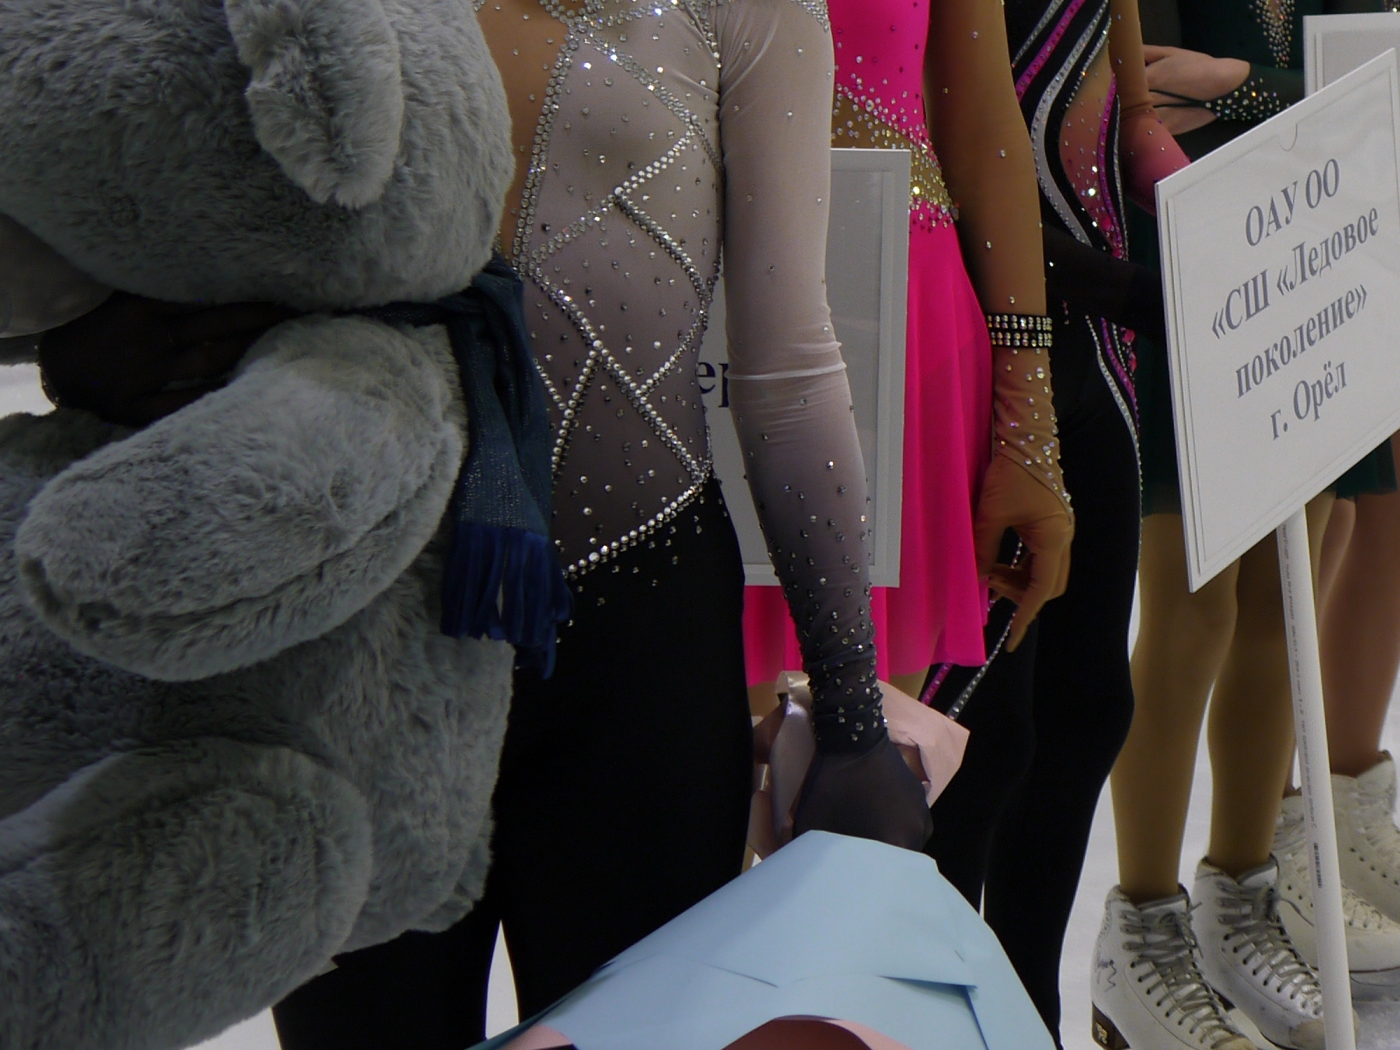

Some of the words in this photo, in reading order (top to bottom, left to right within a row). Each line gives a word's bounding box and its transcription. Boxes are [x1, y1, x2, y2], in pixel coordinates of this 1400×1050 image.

[1245, 180, 1299, 247] ОАУ
[1305, 158, 1340, 210] ОО
[1211, 268, 1271, 340] «СШ
[1276, 207, 1379, 297] «Ледовое
[1235, 284, 1368, 399] поколение»
[1270, 409, 1289, 441] г.
[1293, 360, 1348, 422] Орёл
